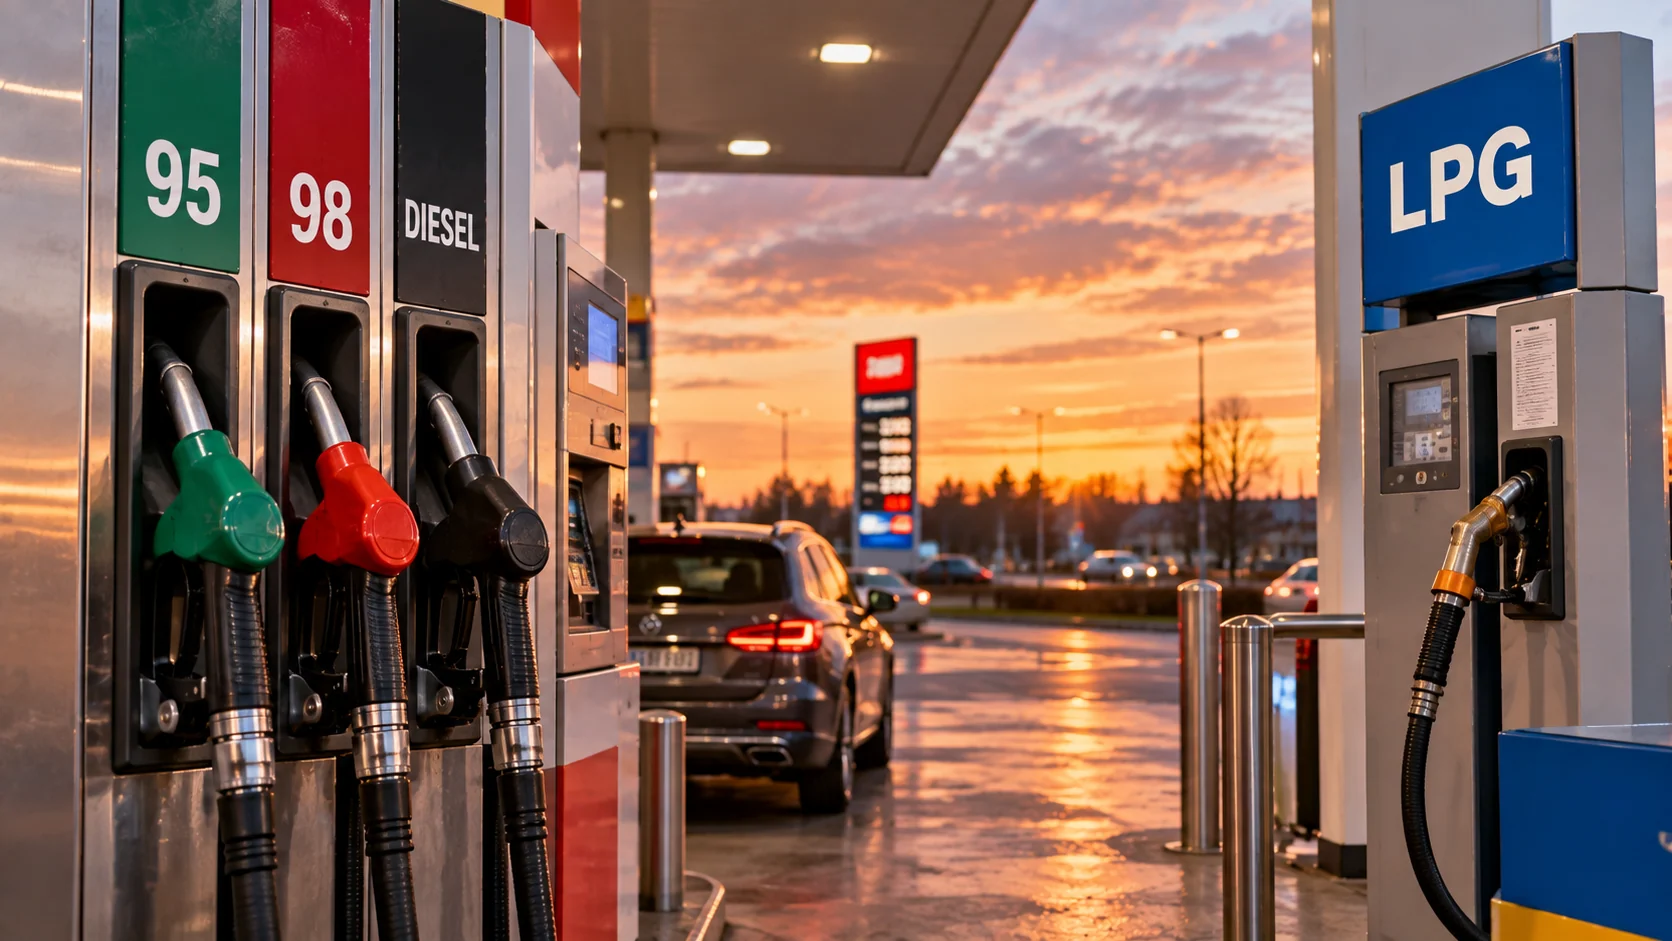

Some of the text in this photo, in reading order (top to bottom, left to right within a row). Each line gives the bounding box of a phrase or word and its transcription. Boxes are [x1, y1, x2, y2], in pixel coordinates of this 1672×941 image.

[145, 138, 221, 226] 95
[289, 172, 353, 251] 98
[1389, 125, 1533, 234] LPG
[404, 198, 480, 252] DIESEL
